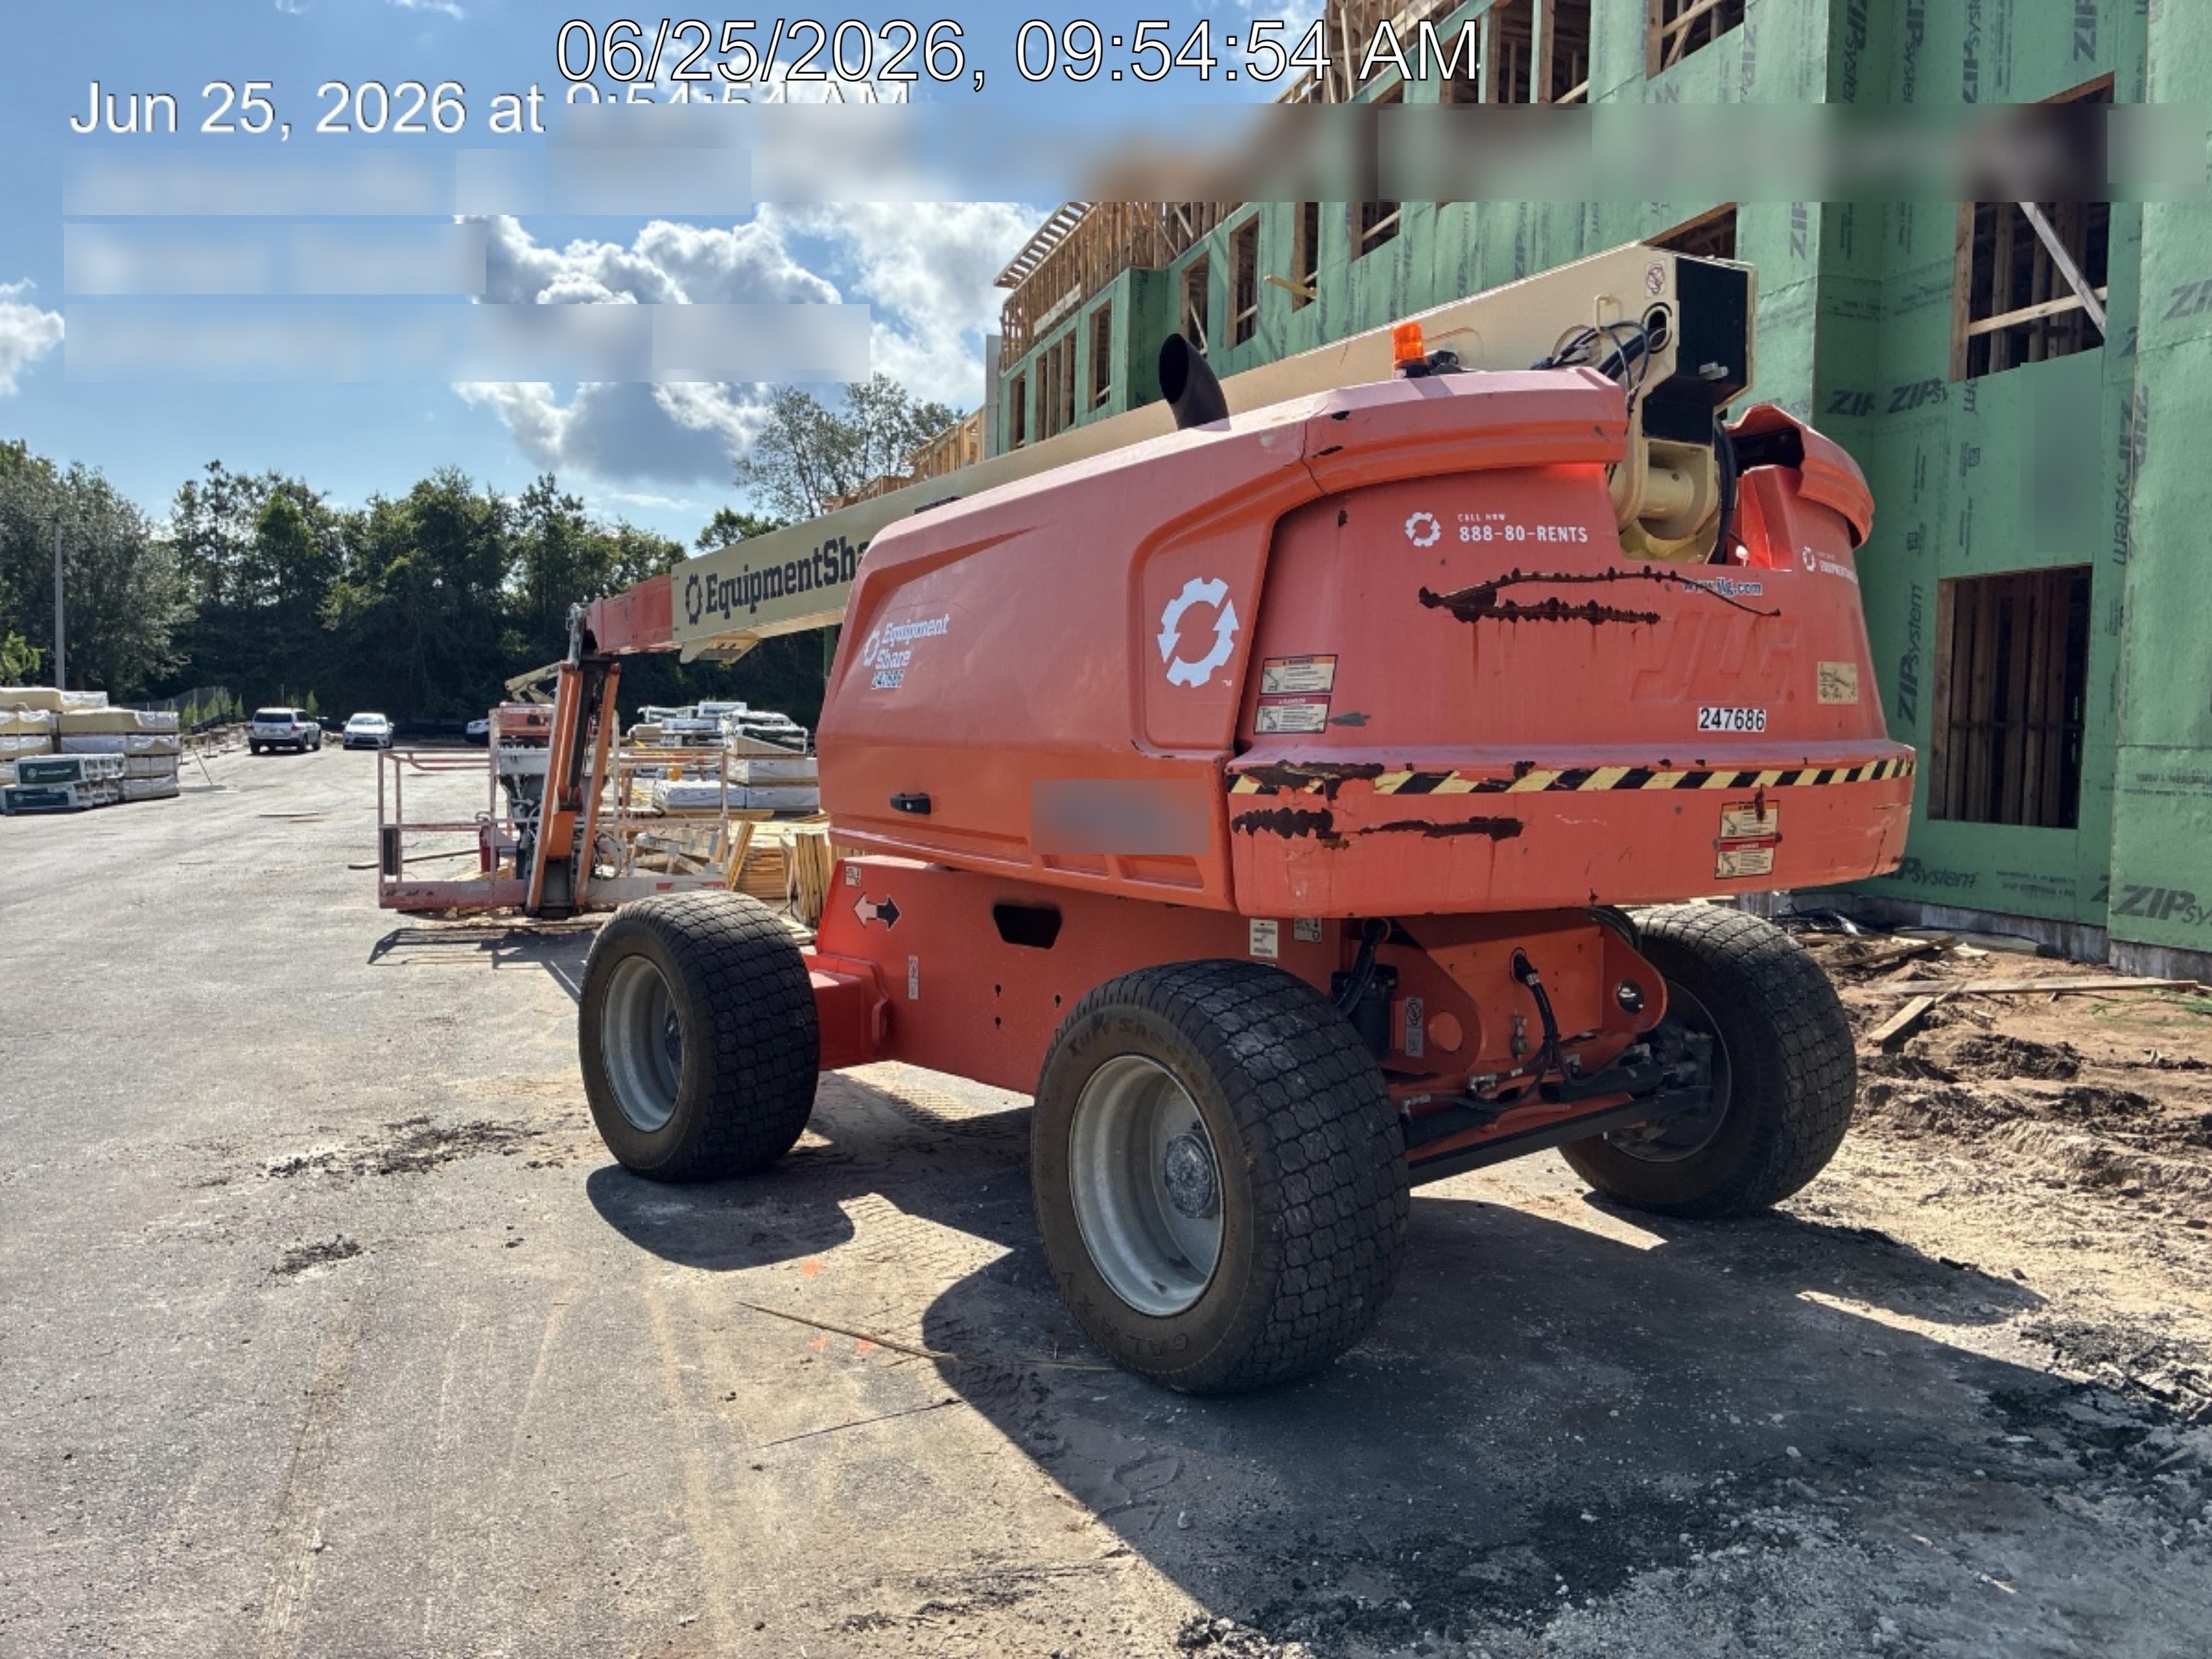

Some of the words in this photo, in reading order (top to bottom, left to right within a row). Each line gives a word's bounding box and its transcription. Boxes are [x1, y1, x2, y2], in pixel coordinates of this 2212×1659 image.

[1459, 525, 1588, 543] 888-80-RENTS
[881, 613, 950, 648] Equipment
[875, 648, 911, 670] Share
[1700, 707, 1765, 730] 247686
